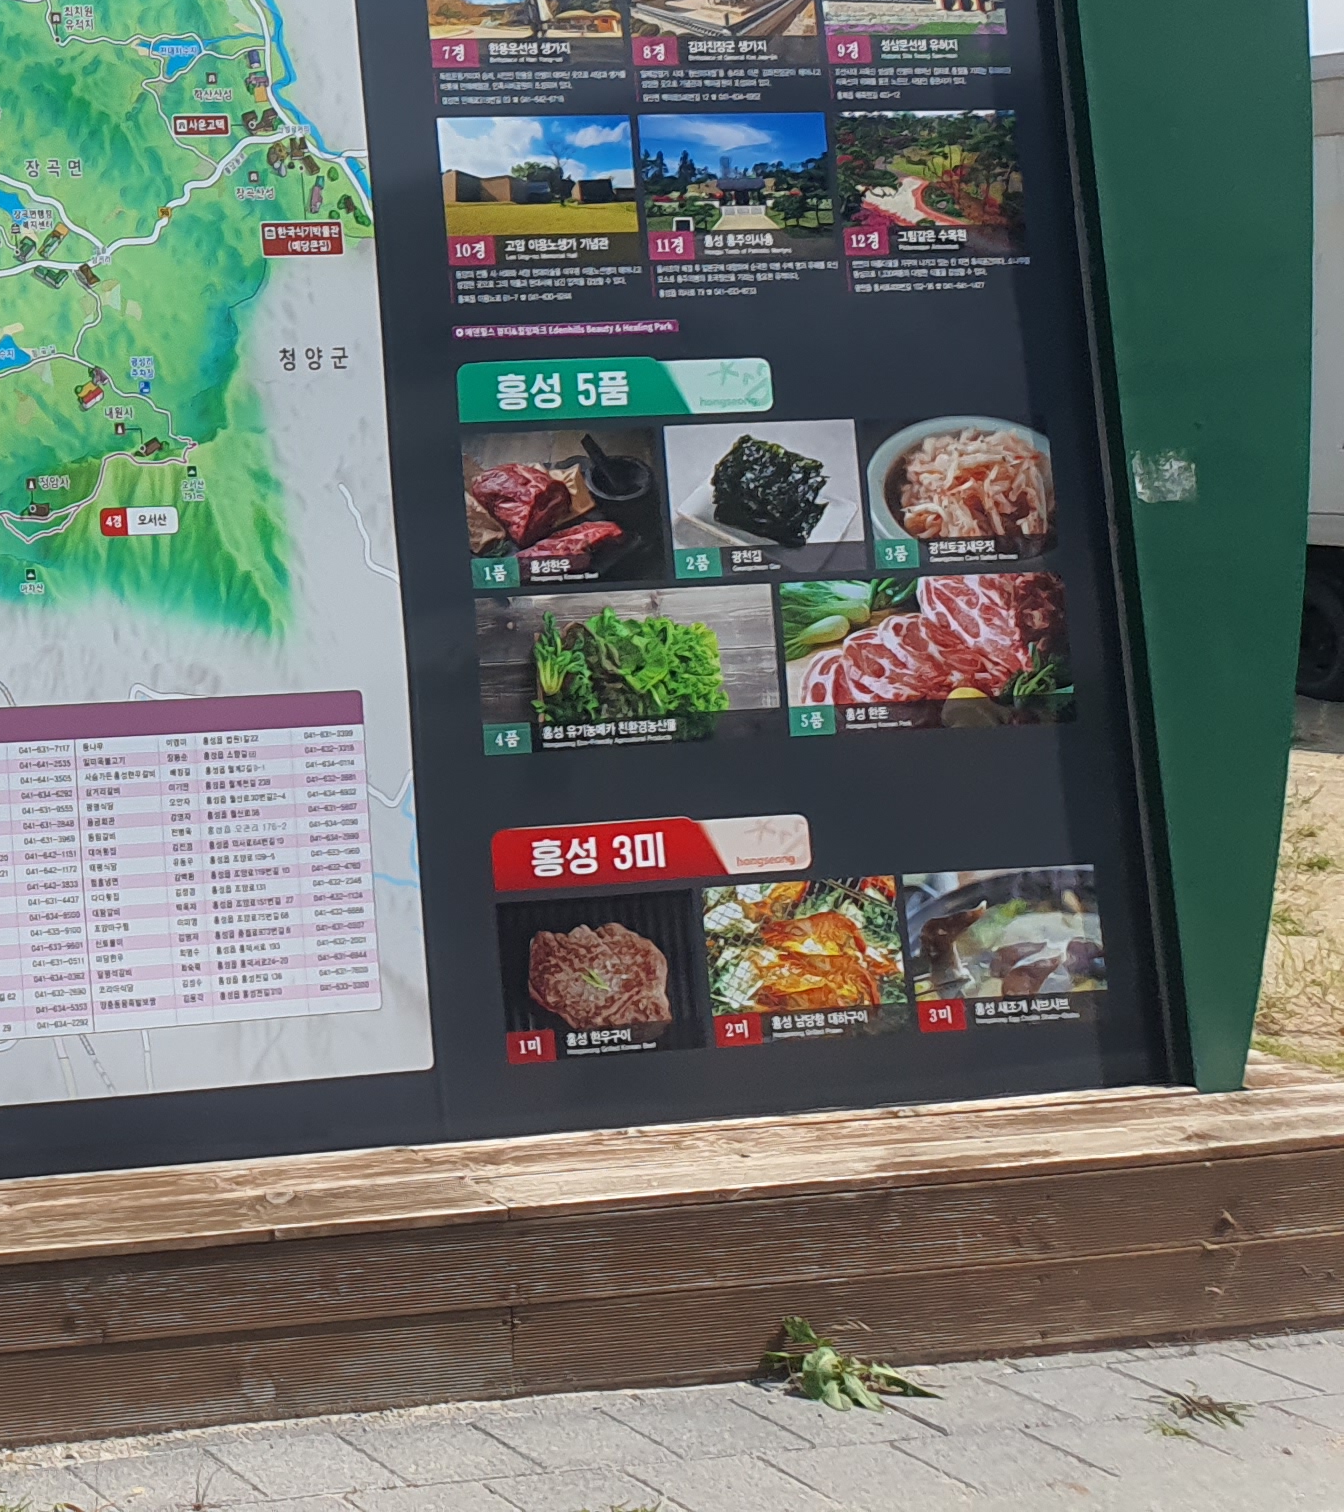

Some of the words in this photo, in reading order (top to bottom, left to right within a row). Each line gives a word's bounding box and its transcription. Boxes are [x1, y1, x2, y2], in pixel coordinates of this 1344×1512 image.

[441, 43, 465, 62] 7경
[643, 43, 665, 60] 8경
[837, 42, 858, 59] 9경
[454, 240, 487, 260] 10경
[655, 237, 684, 254] 11경
[850, 233, 881, 250] 12경
[937, 230, 967, 244] 수목원
[497, 373, 562, 410] 홍성
[577, 370, 630, 407] 5품
[105, 514, 121, 529] 4경
[137, 512, 169, 528] 오서산
[687, 553, 710, 572] 2품
[731, 549, 762, 564] 광천김
[885, 543, 908, 562] 3품
[483, 563, 507, 582] 1품
[801, 710, 824, 729] 5품
[869, 707, 888, 720] 한돈
[495, 728, 520, 748] 4품
[531, 840, 598, 877] 홍성
[612, 831, 666, 871] 3미
[929, 1005, 953, 1024] 3미
[726, 1018, 748, 1038] 2미
[519, 1035, 542, 1056] 1미
